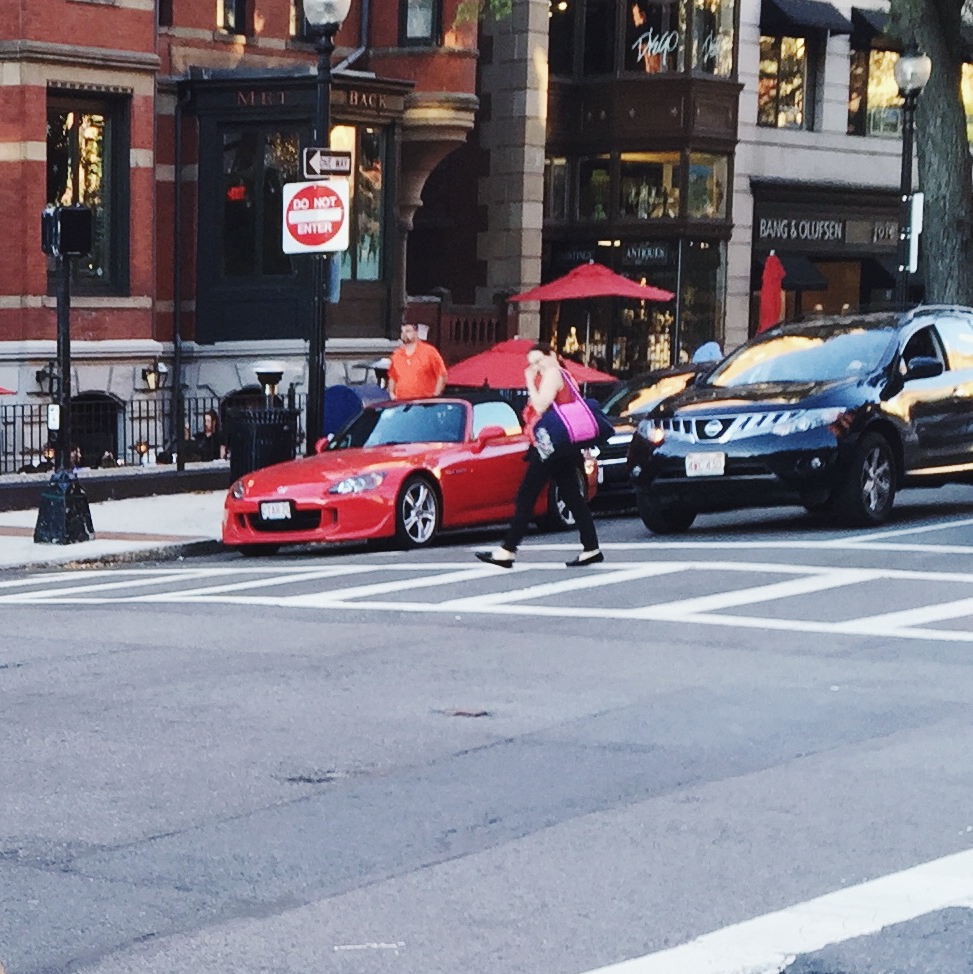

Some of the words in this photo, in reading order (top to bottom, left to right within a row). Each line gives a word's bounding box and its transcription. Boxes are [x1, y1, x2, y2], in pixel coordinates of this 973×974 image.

[237, 89, 290, 107] MET
[349, 90, 387, 109] BACK
[293, 198, 309, 209] DO
[314, 196, 337, 208] NOT
[297, 222, 333, 234] ENTER
[759, 218, 788, 239] BANG
[790, 220, 798, 239] &
[799, 220, 843, 240] OLUFSEN
